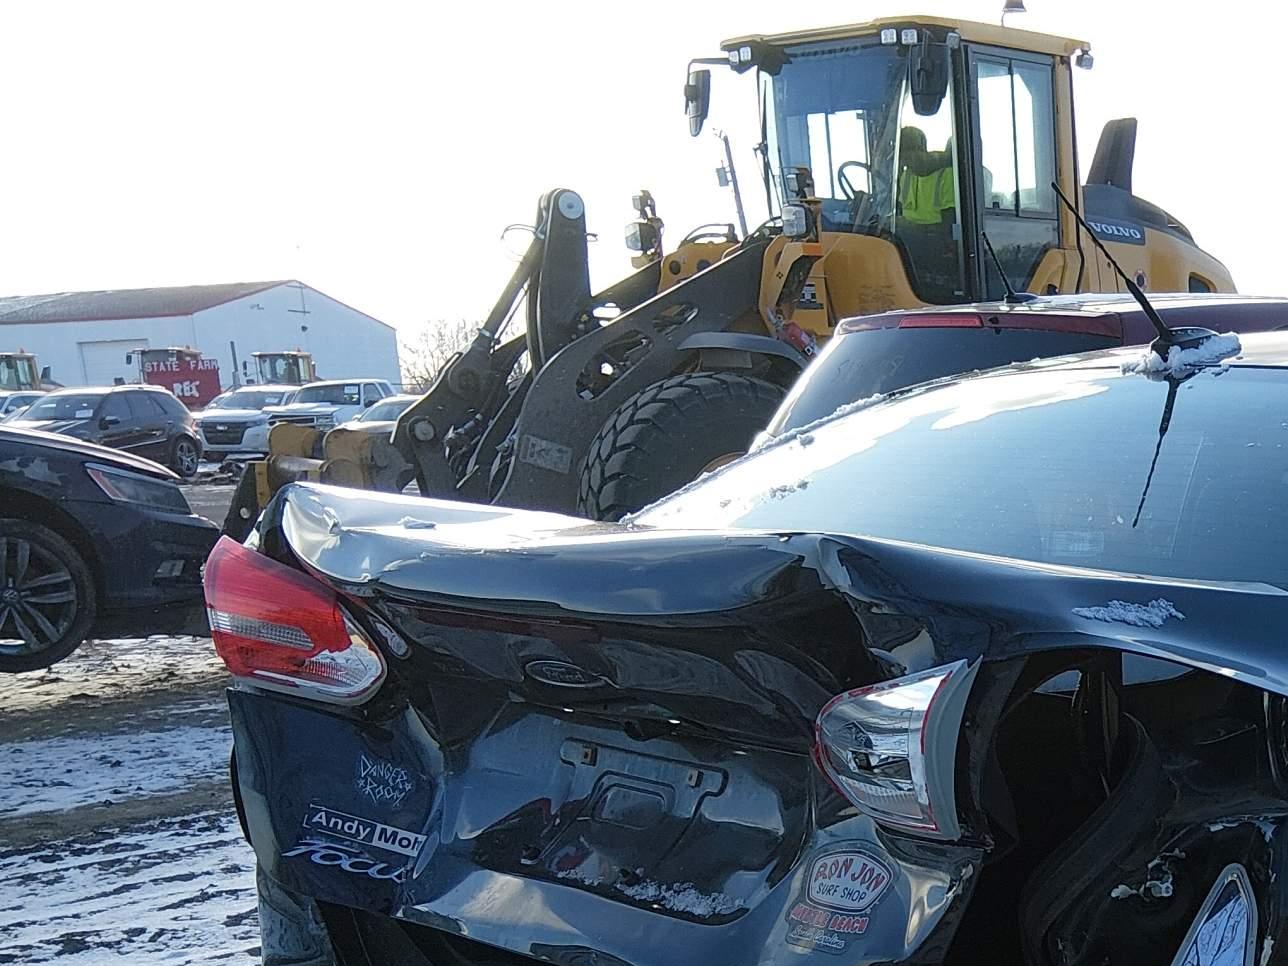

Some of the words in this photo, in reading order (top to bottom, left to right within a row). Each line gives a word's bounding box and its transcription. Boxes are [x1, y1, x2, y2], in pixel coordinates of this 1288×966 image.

[1087, 221, 1142, 239] VOLVO
[144, 361, 181, 373] STATE
[190, 359, 219, 371] FARM
[312, 811, 372, 840] Andy
[814, 857, 854, 882] RON
[850, 863, 886, 894] JON
[816, 882, 840, 897] SURF
[840, 886, 867, 903] SHOP
[829, 914, 869, 934] BEACH
